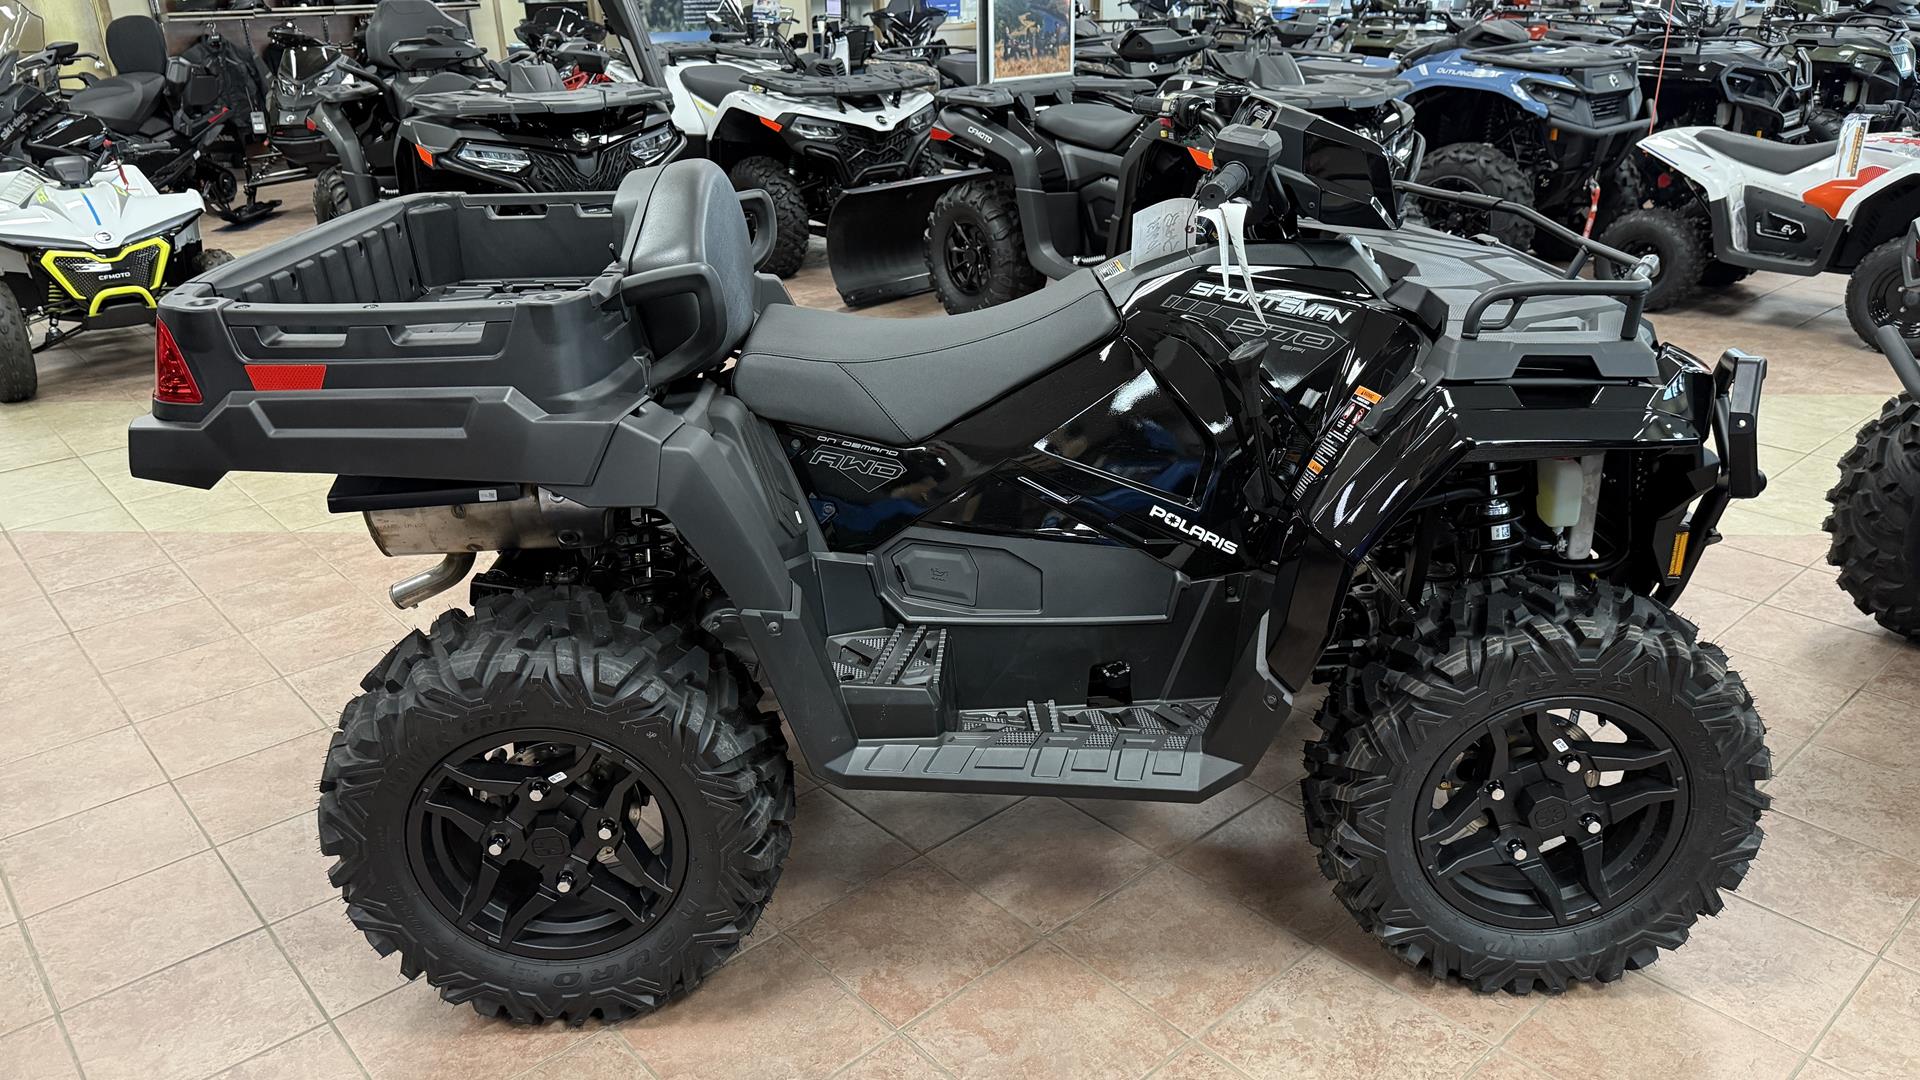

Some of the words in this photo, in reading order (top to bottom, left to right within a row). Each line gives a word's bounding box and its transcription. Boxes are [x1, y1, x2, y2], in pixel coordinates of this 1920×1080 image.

[967, 125, 993, 144] CFMOTO
[1780, 224, 1797, 235] EV
[98, 271, 131, 281] CFMOTO
[1225, 317, 1336, 350] 570
[816, 435, 837, 444] ON
[841, 441, 899, 457] DEMAND
[808, 449, 904, 480] AWD
[1148, 504, 1238, 555] POLARIS
